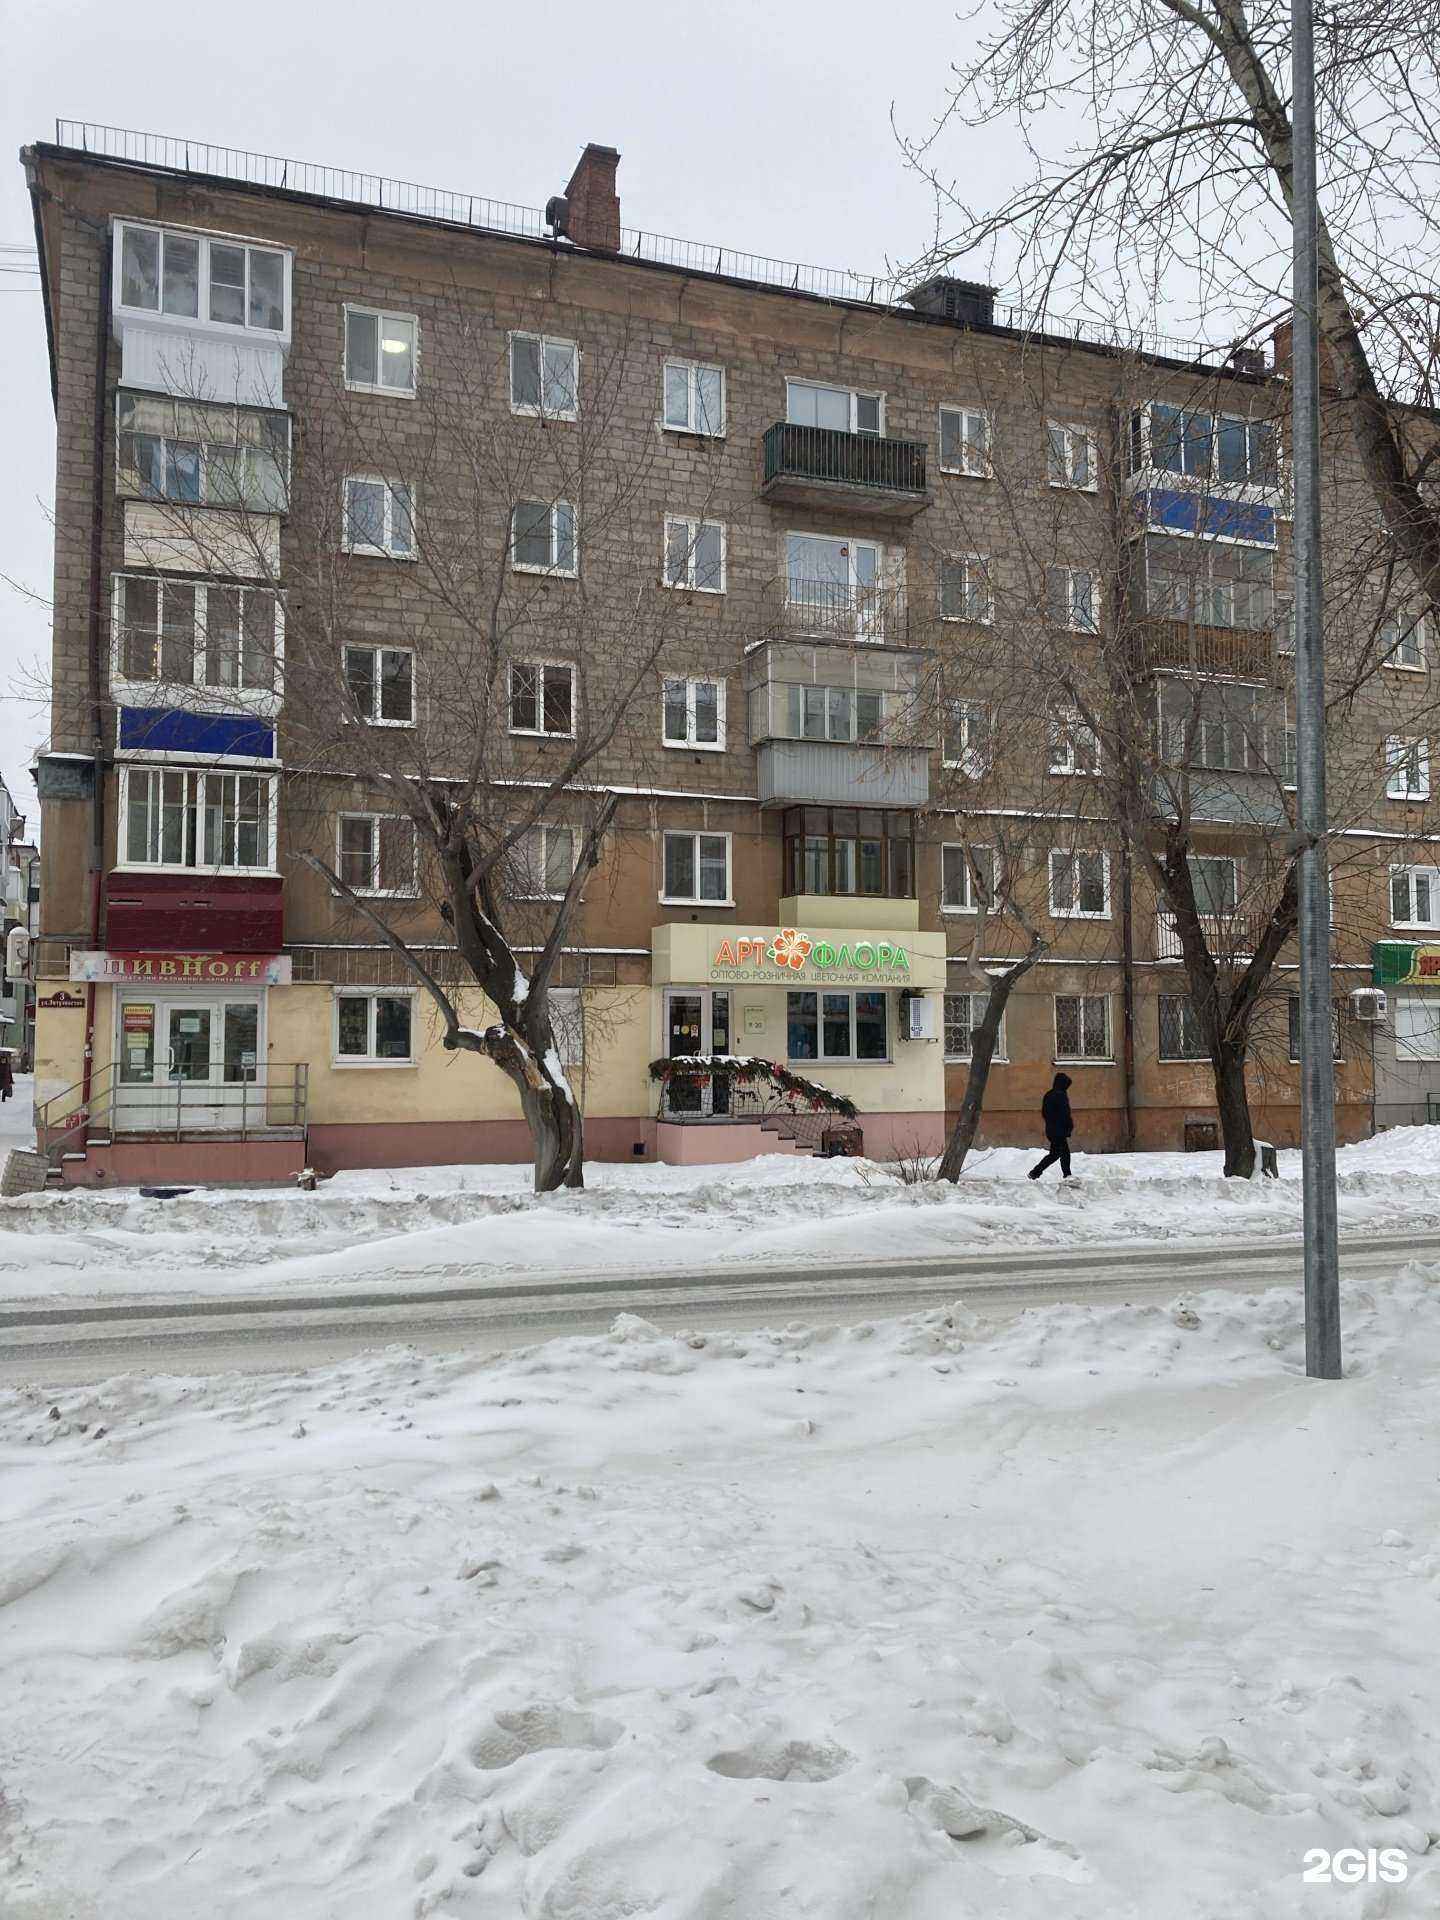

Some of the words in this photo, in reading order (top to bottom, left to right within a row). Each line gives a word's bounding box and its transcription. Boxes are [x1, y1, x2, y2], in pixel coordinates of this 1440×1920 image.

[715, 940, 767, 966] АРТ
[811, 942, 910, 971] ФЛОРА
[710, 970, 806, 982] ОПТОВО-РОЗНИЧНАЯ
[811, 972, 859, 983] ЦВЕТОЧНАЯ
[861, 973, 911, 984] КОМПАНИЯ
